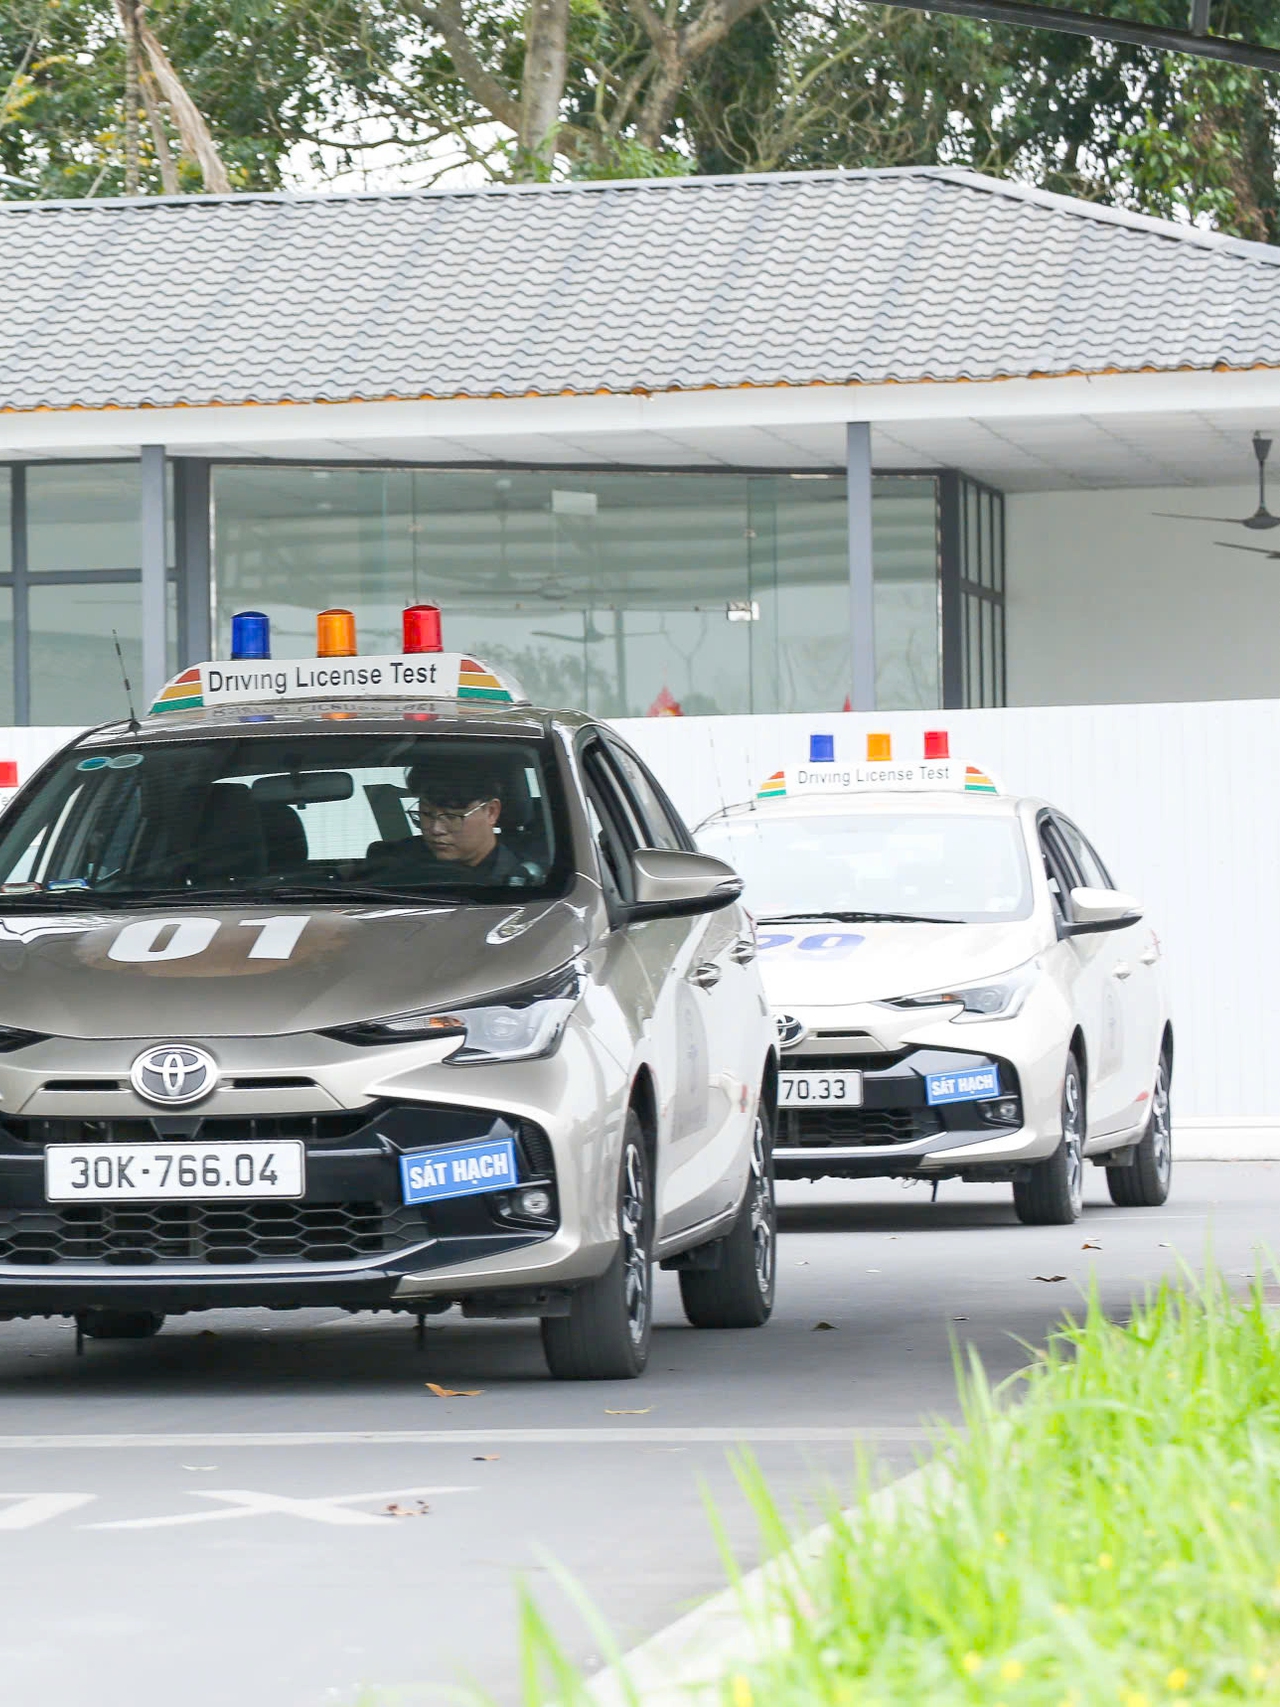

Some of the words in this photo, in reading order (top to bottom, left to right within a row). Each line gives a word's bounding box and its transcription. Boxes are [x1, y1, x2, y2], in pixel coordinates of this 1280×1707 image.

[208, 670, 287, 695] Driving
[296, 666, 383, 688] License
[389, 662, 438, 684] Test
[797, 770, 851, 787] Driving
[856, 768, 914, 782] License
[919, 766, 950, 780] Test
[106, 914, 312, 963] 01
[931, 1077, 958, 1097] SÁT
[958, 1074, 994, 1095] HẠCH
[409, 1158, 447, 1190] SÁT
[450, 1152, 510, 1184] HẠCH
